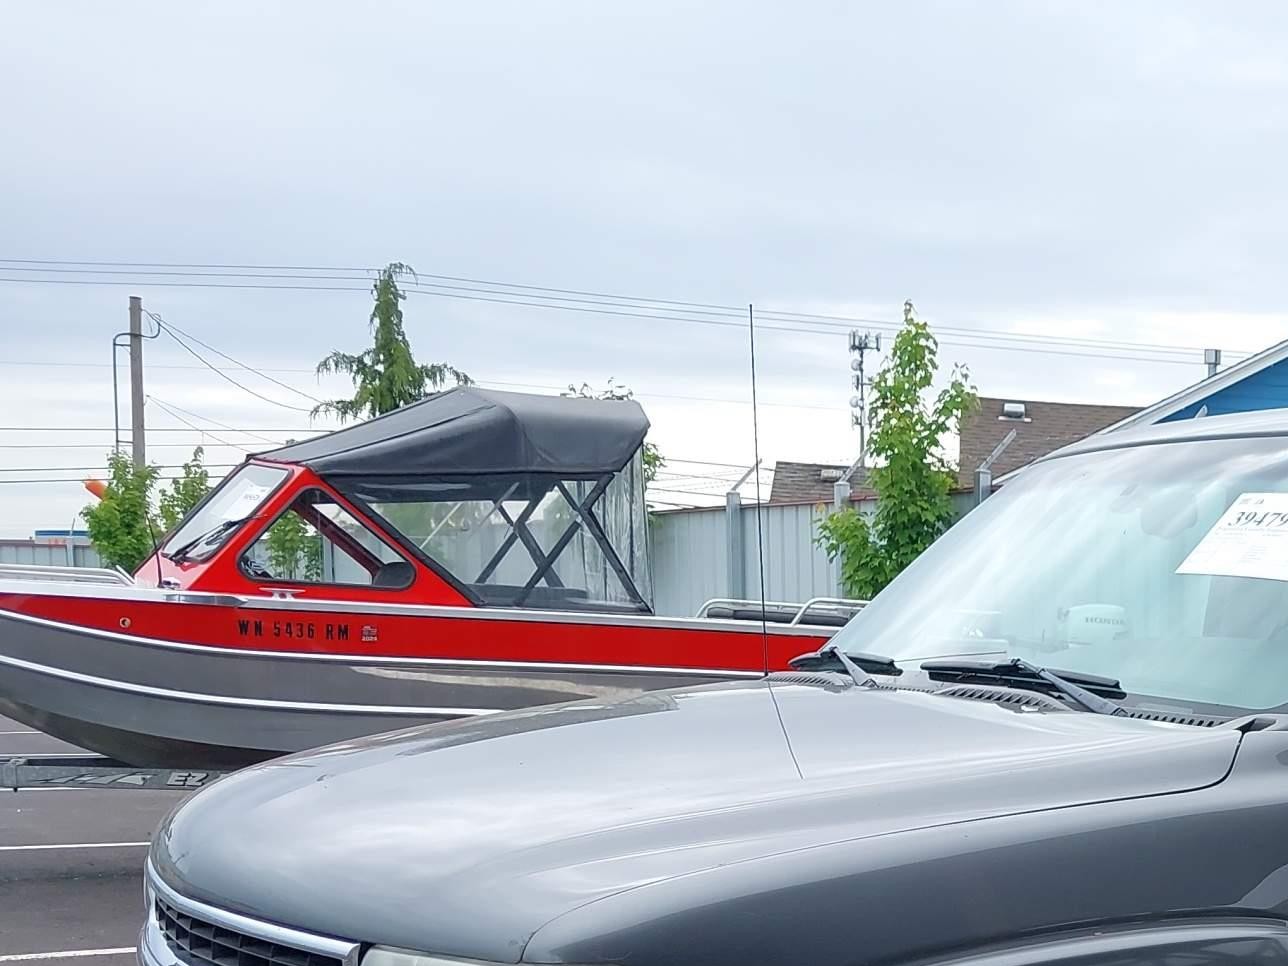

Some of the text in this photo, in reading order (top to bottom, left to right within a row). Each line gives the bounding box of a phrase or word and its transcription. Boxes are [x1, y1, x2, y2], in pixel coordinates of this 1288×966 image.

[238, 619, 263, 637] WN
[273, 620, 315, 639] 5436
[326, 623, 349, 641] RM
[167, 771, 208, 786] EZ
